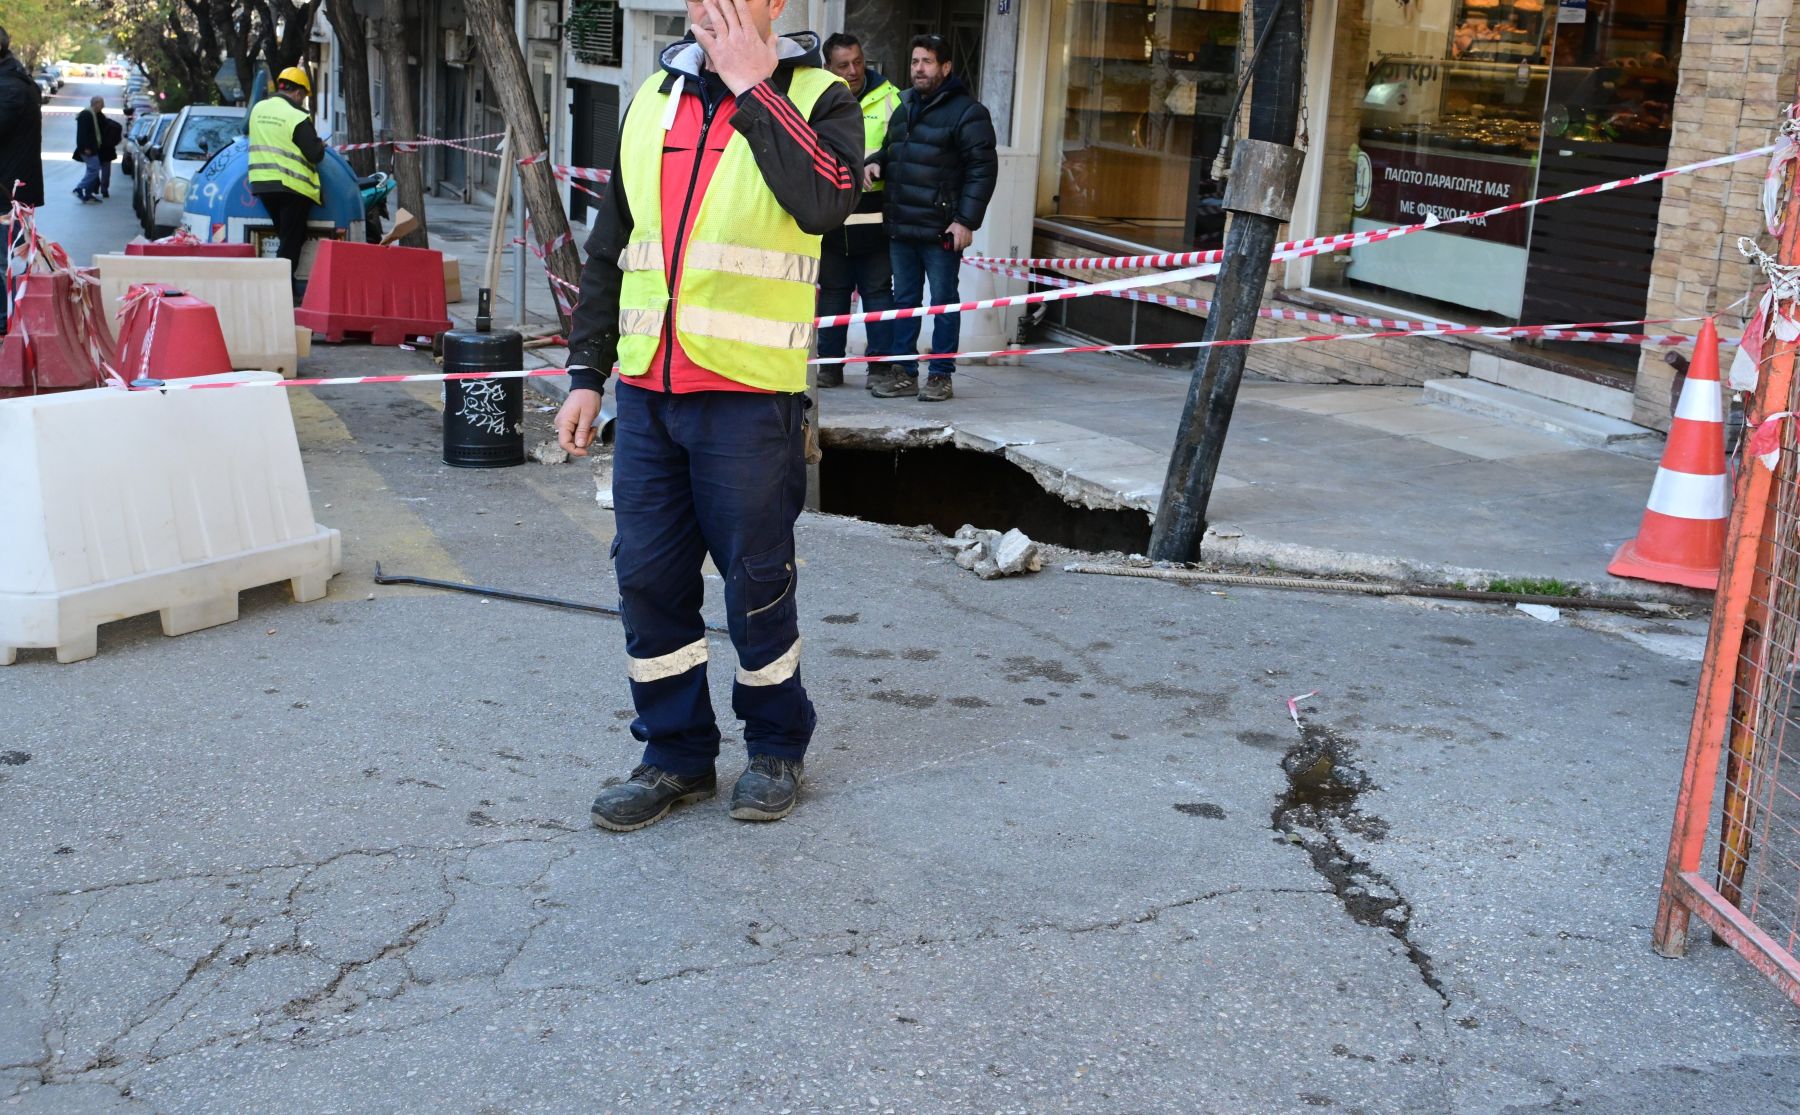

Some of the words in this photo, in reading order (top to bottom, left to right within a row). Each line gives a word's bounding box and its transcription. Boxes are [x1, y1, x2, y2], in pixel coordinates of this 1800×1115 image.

[1384, 167, 1422, 184] ΠΑΓΩΤΟ
[1424, 172, 1483, 193] ΠΑΡΑΓΩΓΗΣ
[1484, 181, 1510, 198] ΜΑΣ
[1400, 200, 1415, 214] ΜΕ
